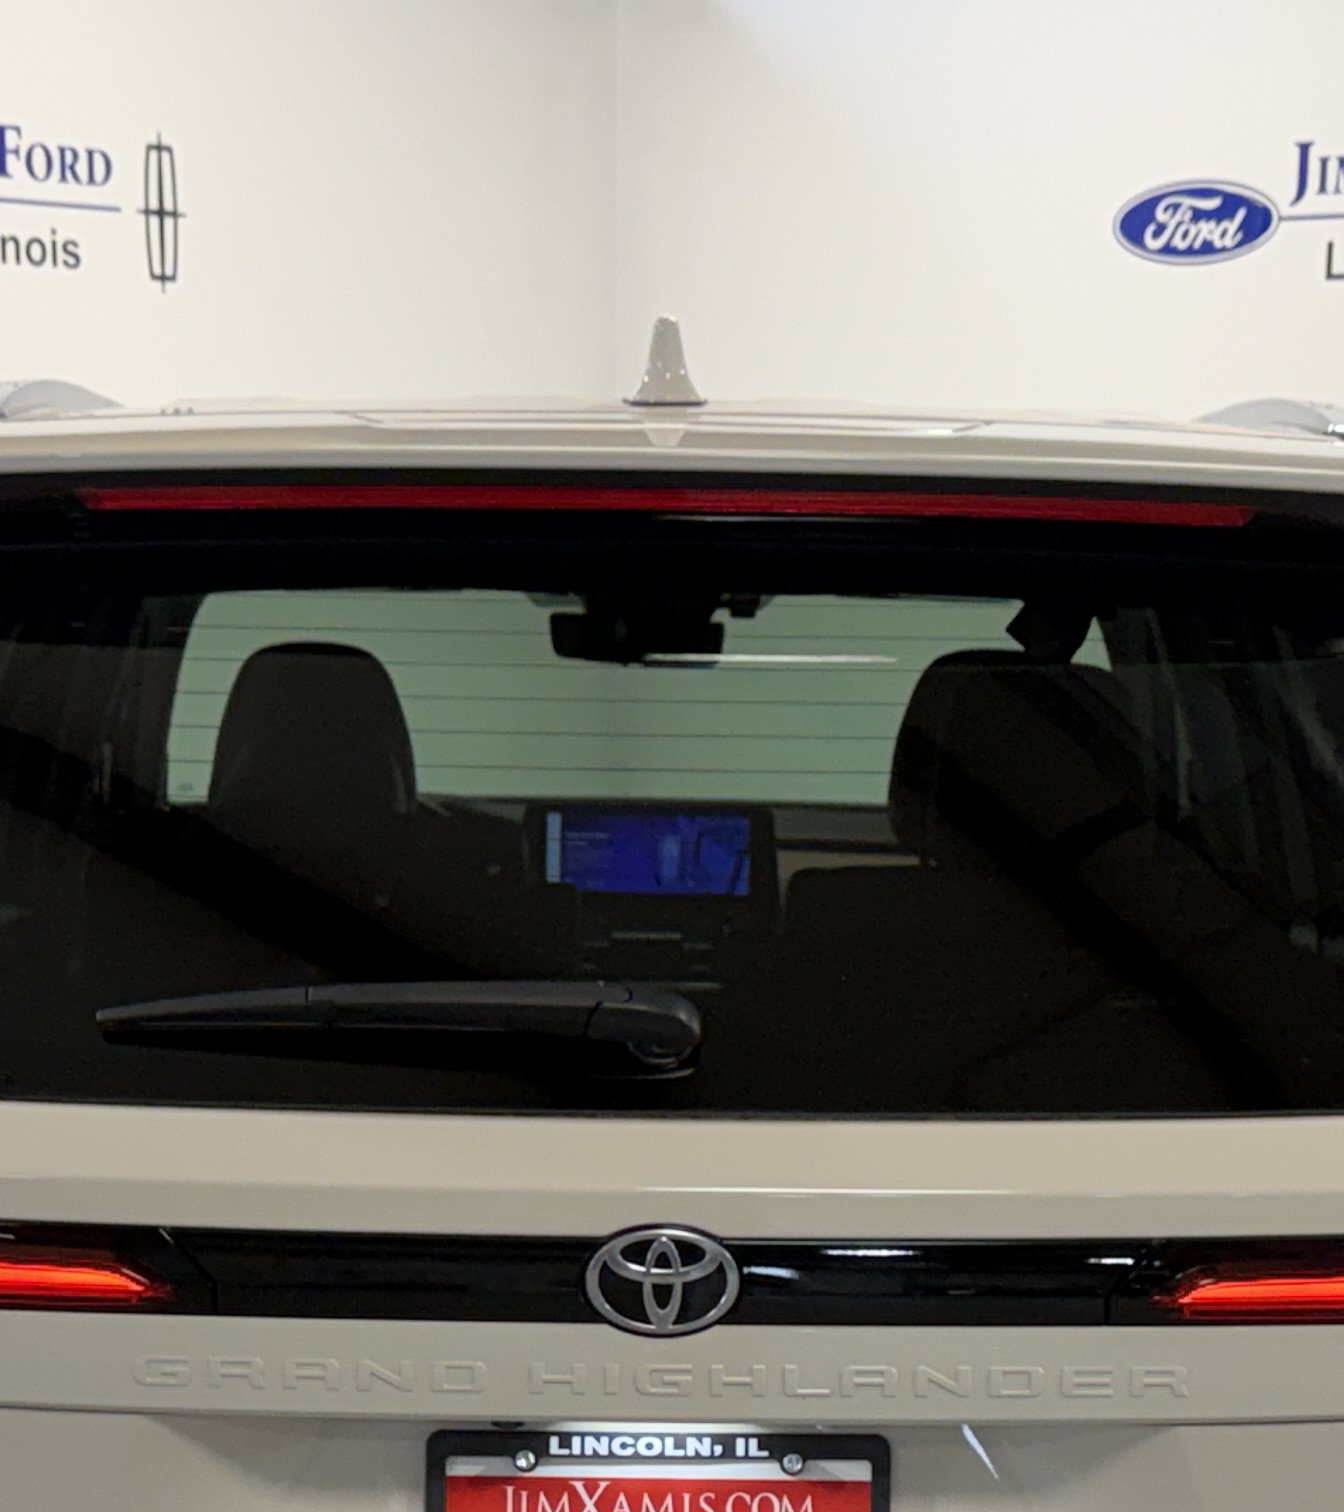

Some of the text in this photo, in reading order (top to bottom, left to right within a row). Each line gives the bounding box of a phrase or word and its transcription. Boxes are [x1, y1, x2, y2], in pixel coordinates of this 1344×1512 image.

[1143, 196, 1243, 251] Ford
[132, 1355, 1190, 1399] GRAND HIGHLANDER
[549, 1435, 769, 1457] LINCOLN, IL
